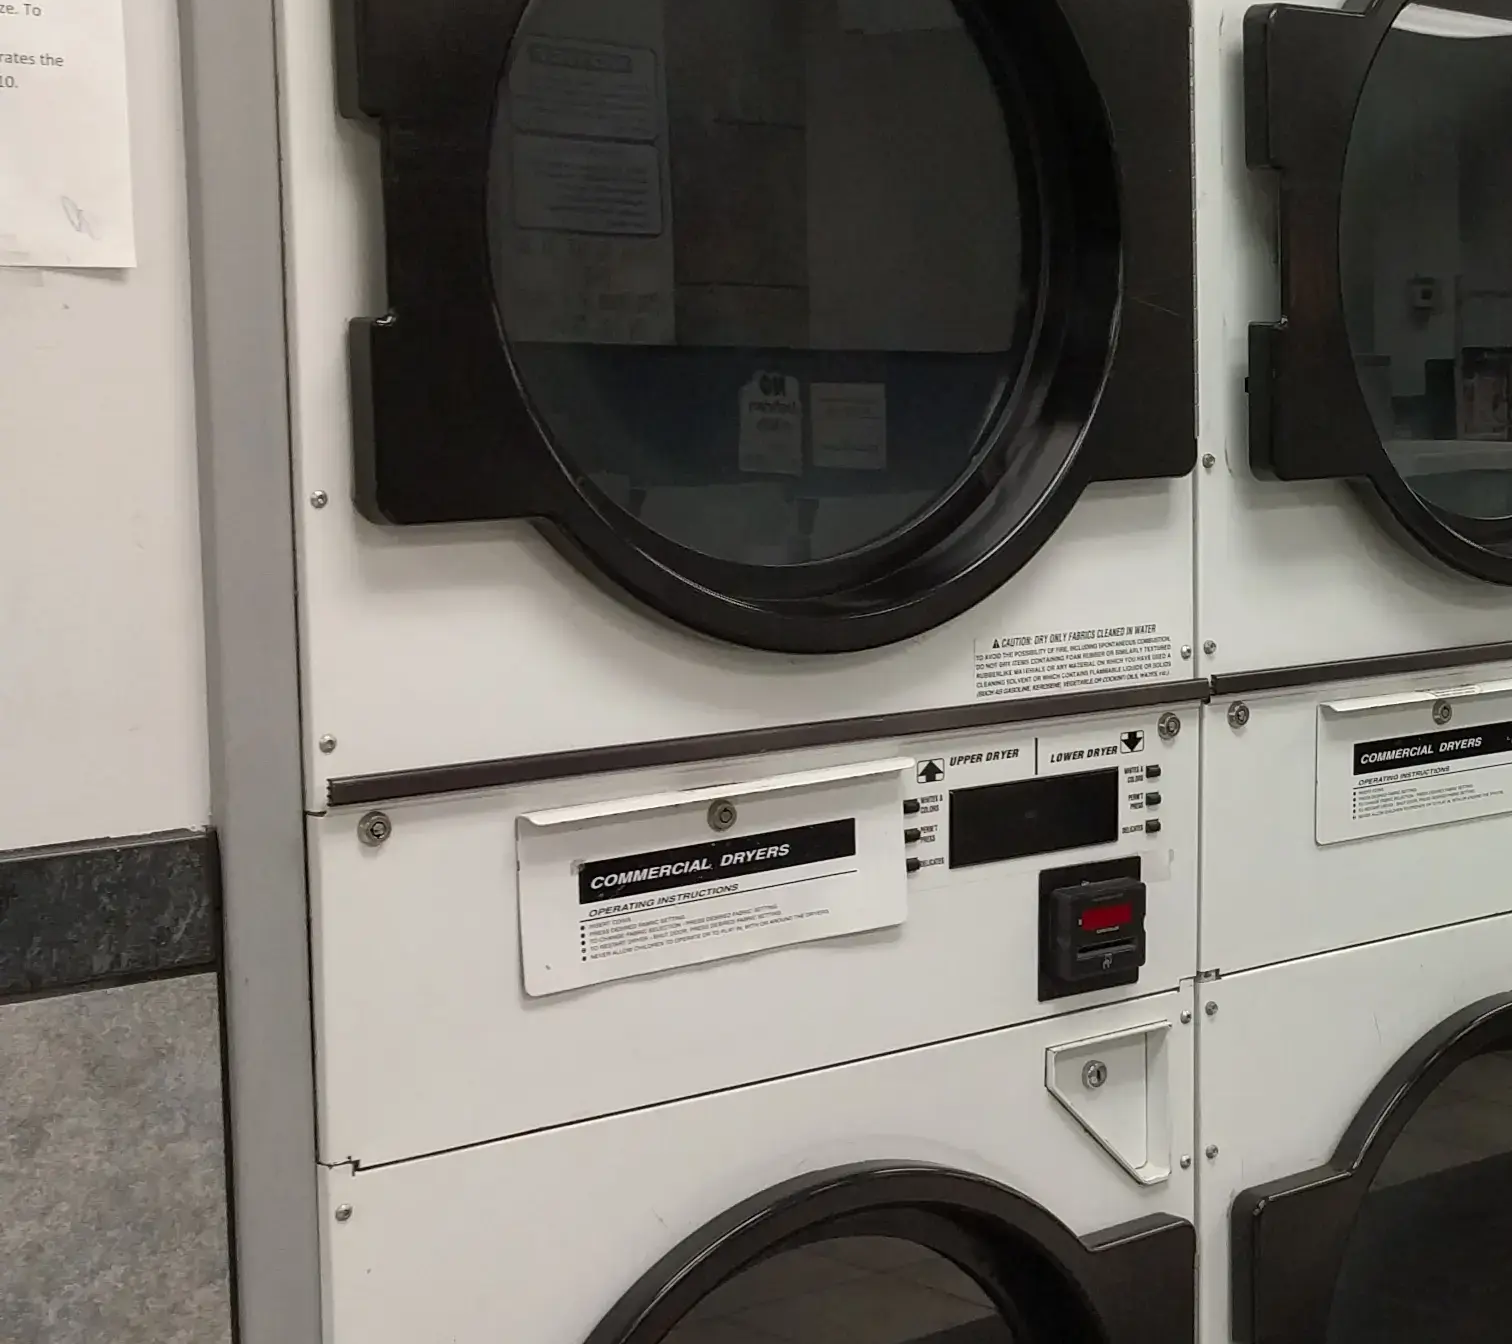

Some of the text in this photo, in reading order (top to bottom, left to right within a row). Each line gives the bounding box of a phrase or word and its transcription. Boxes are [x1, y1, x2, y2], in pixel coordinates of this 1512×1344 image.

[23, 3, 42, 16] To
[40, 53, 65, 66] the
[1097, 626, 1125, 638] CLEANED
[1134, 624, 1157, 635] WATER
[949, 748, 1020, 767] UPPER DRYER
[1050, 745, 1118, 764] LOWER DRYER
[1360, 736, 1483, 765] COMMERCIAL DRYERS
[1358, 765, 1451, 786] OPERATING INSTRUCTIONS
[590, 843, 791, 890] COMMERCIAL DRYERS
[588, 883, 739, 918] OPERATING INSTRUCTIONS
